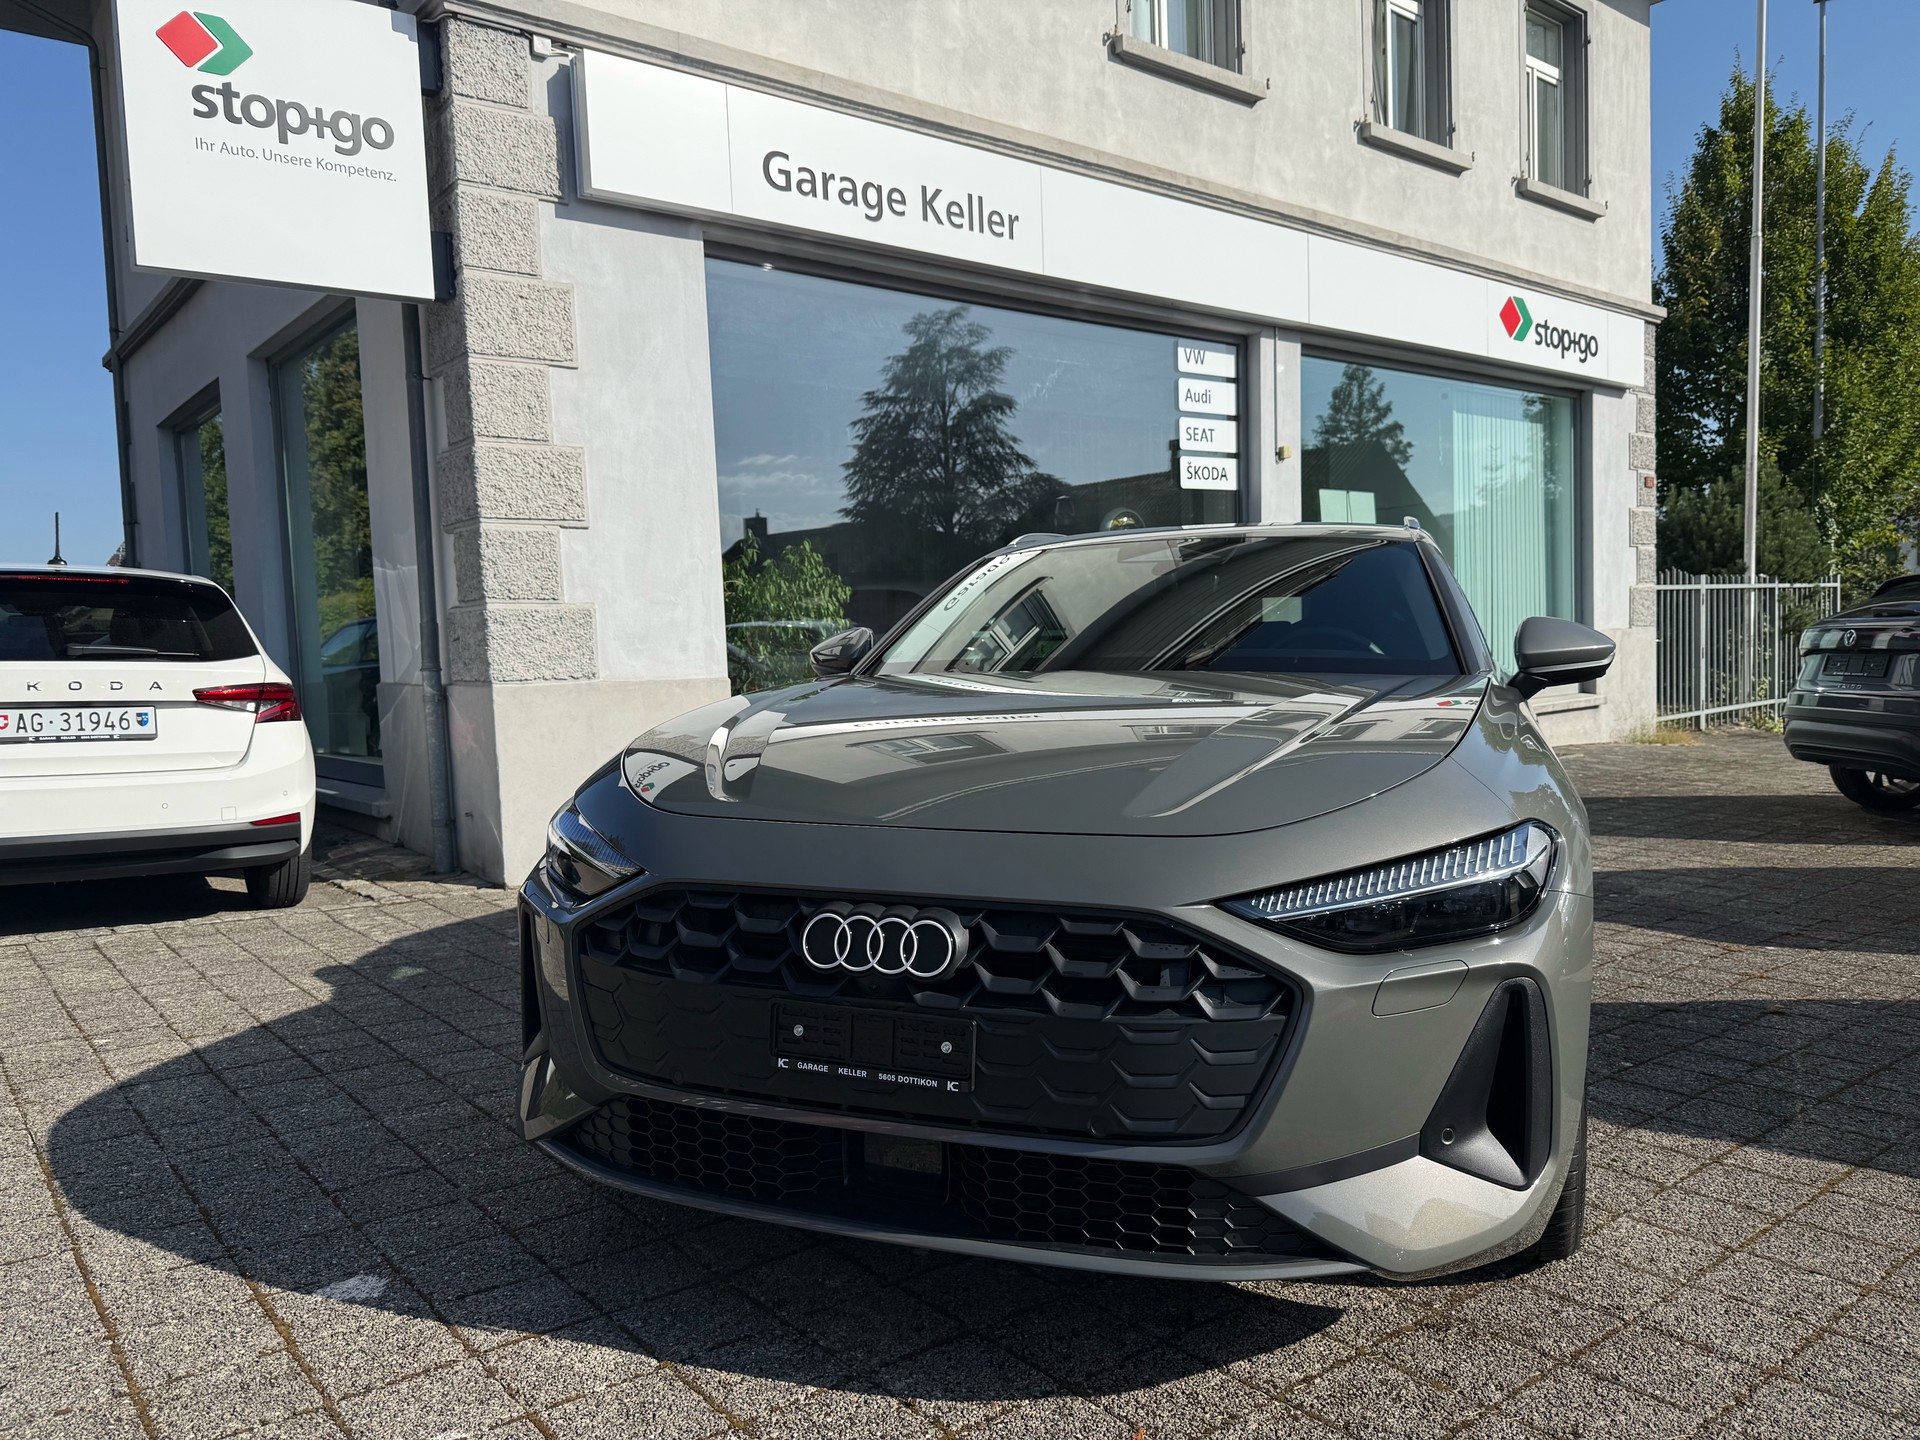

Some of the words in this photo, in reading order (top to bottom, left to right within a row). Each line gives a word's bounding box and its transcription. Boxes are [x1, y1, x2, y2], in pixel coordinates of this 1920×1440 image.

[191, 81, 396, 157] stop+go
[194, 136, 216, 153] Ihr
[219, 141, 260, 160] Auto.
[262, 148, 313, 168] Unsere
[316, 156, 398, 183] Kompetenz.
[762, 150, 908, 223] Garage
[920, 184, 1020, 241] Keller
[1534, 319, 1599, 364] stop+go
[1184, 347, 1206, 366] VW
[1184, 387, 1212, 405] Audi
[1185, 426, 1215, 443] SEAT
[1186, 462, 1229, 482] ŠKODA
[797, 1061, 829, 1073] GARAGE
[838, 1067, 867, 1078] KELLER
[878, 1073, 896, 1082] 5605
[897, 1075, 938, 1088] DOTTIKON
